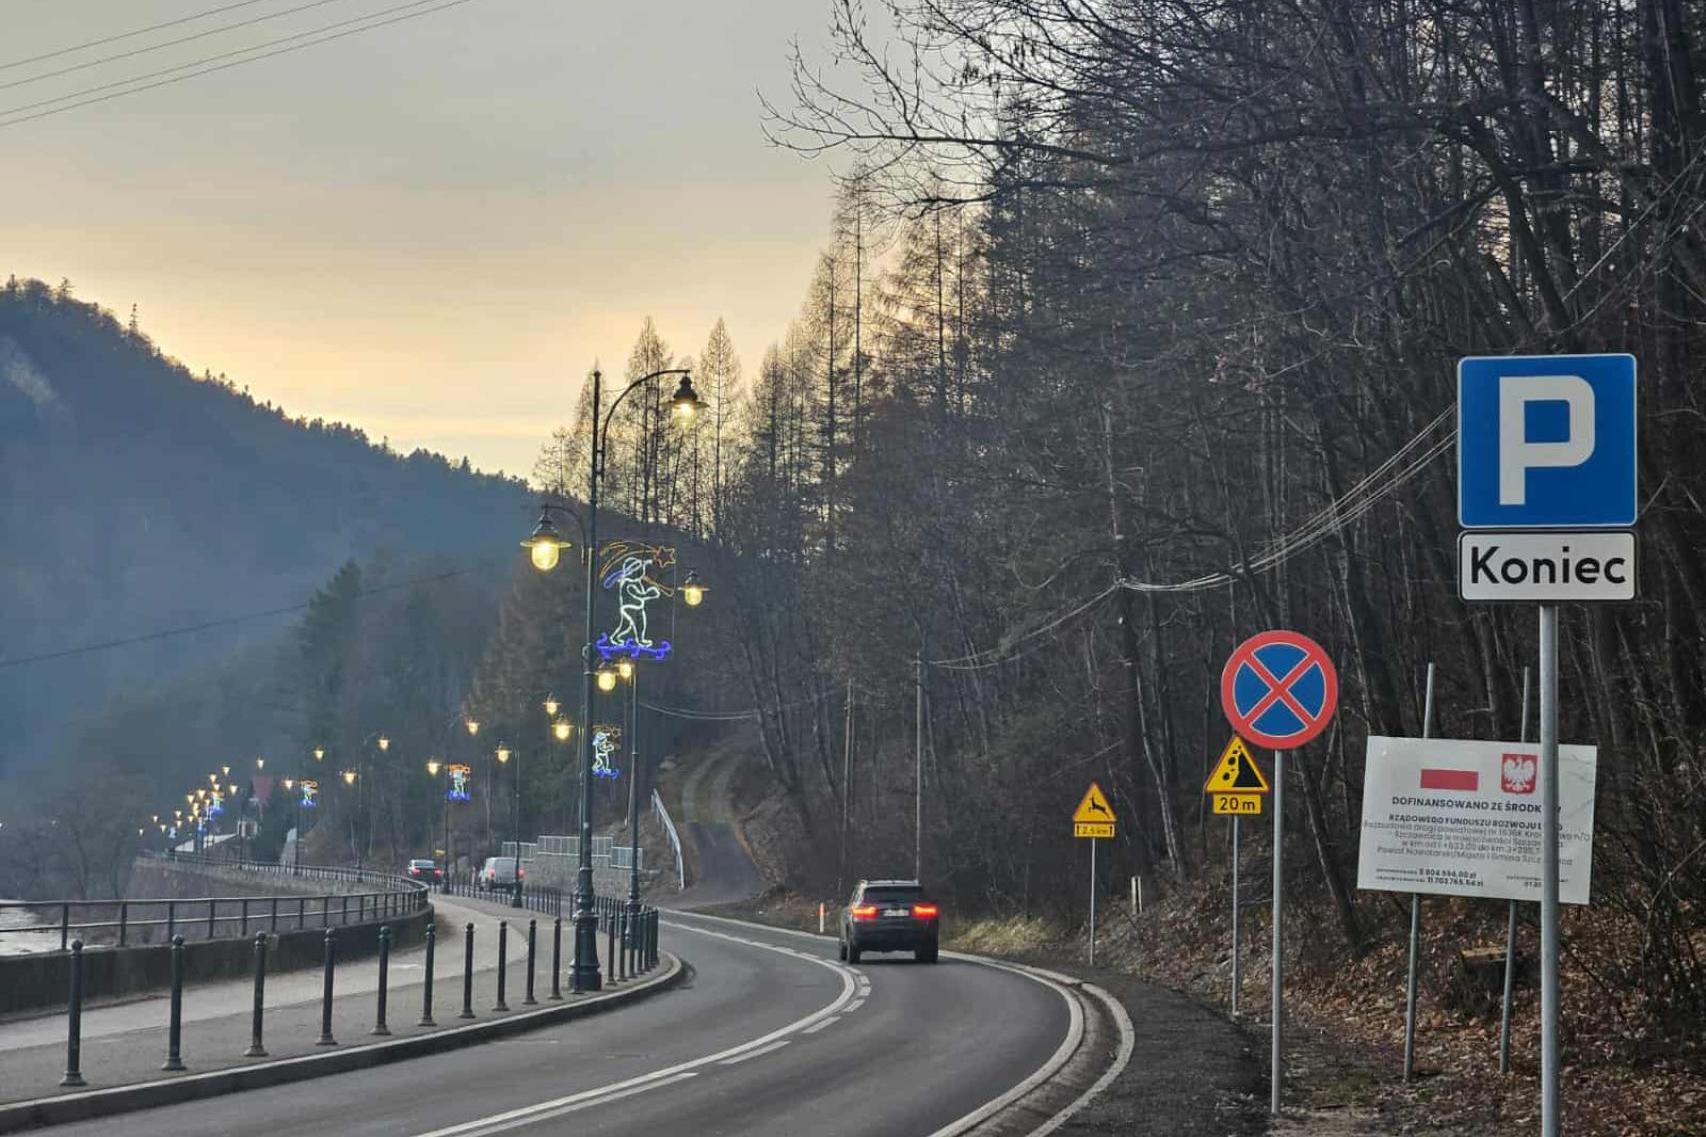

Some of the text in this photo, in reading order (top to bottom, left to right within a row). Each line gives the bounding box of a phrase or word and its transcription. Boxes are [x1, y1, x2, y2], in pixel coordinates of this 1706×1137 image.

[1499, 374, 1596, 506] P
[1471, 545, 1626, 585] Koniec
[1219, 796, 1255, 811] 20 m
[1391, 796, 1561, 813] DOFINANSOWANO ZE ŚRODK
[1445, 817, 1491, 827] FUNDUSZU
[1492, 820, 1536, 830] ROZWOJU
